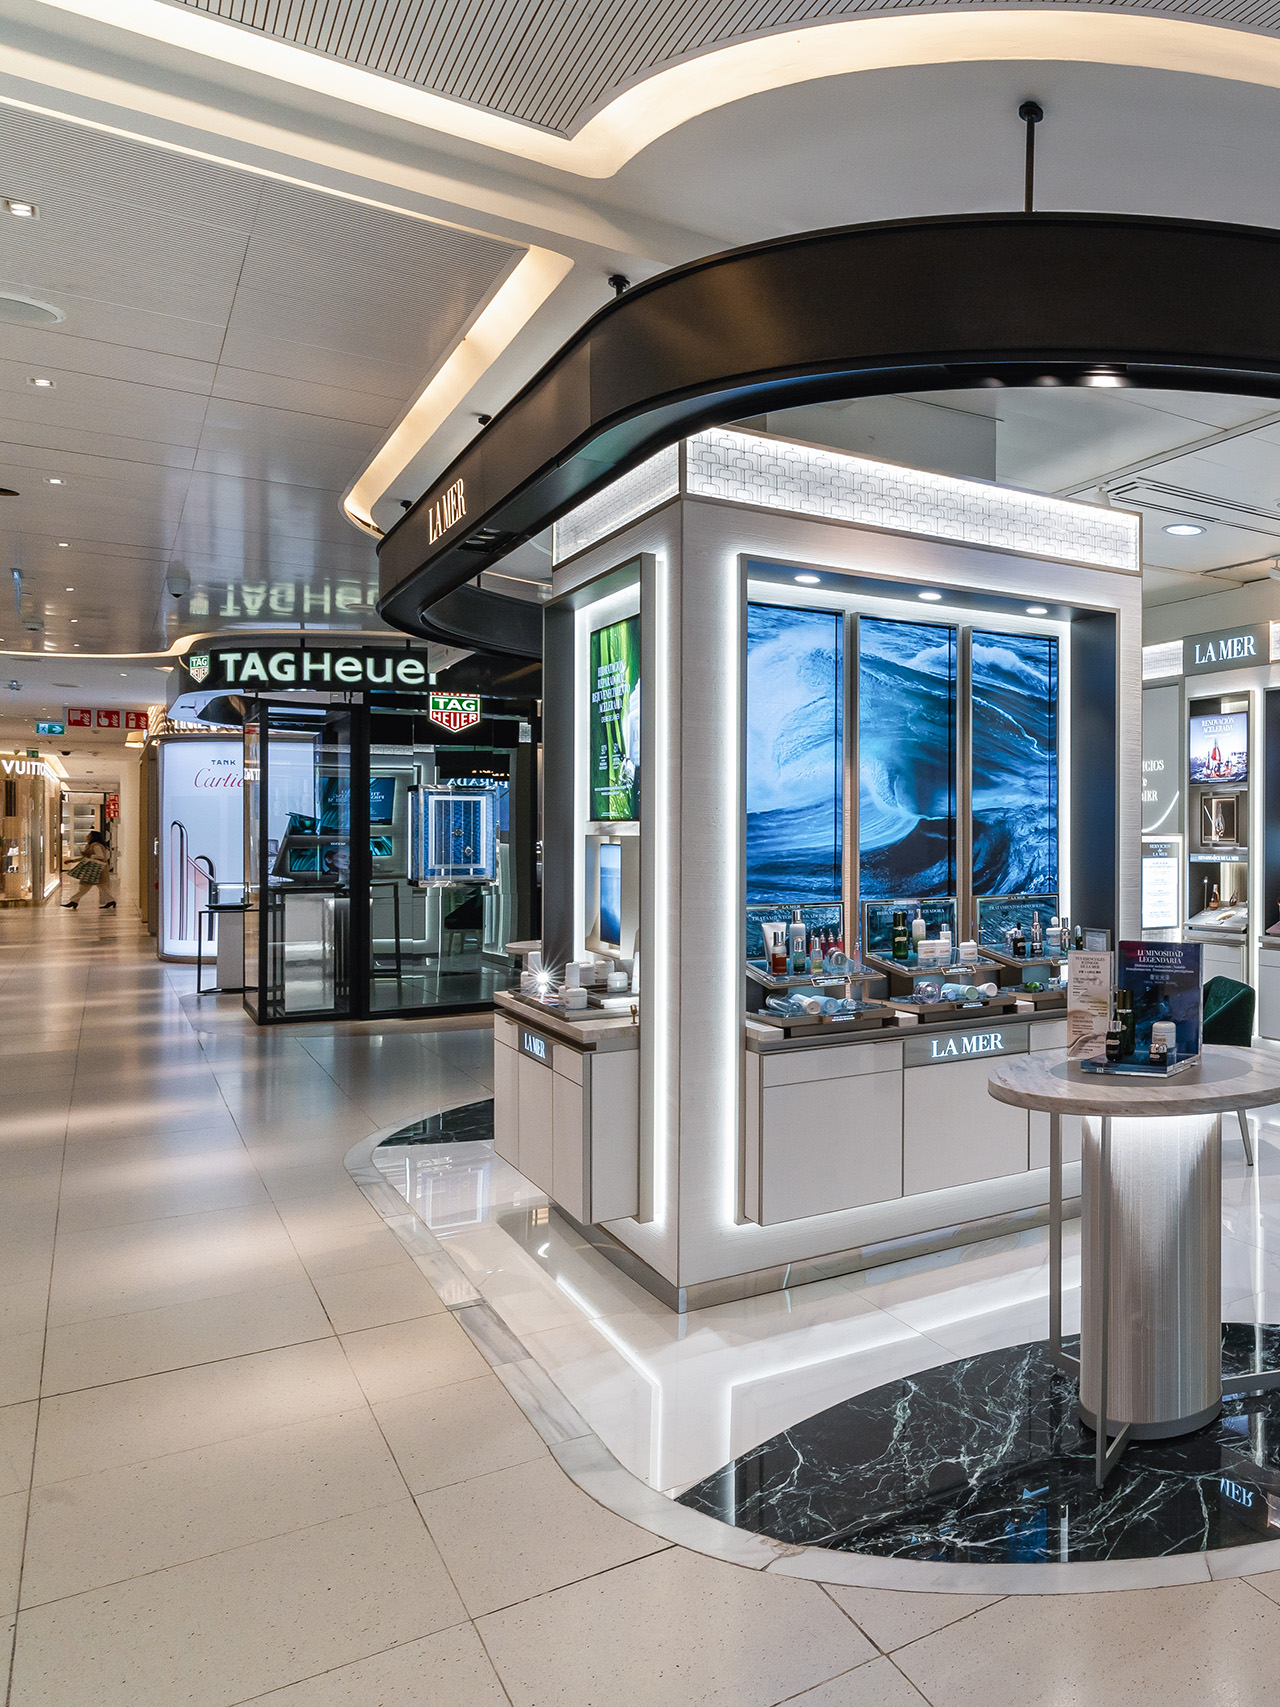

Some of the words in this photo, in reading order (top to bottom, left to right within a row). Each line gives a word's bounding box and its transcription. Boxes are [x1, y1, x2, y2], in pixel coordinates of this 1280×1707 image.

[428, 501, 443, 545] LA
[442, 478, 467, 533] MER
[1195, 641, 1217, 664] LA
[1218, 635, 1256, 661] MER
[191, 657, 208, 667] TAG
[434, 697, 476, 711] TAG
[432, 711, 477, 730] HEUER
[1137, 949, 1184, 958] LUMINOSIDAD
[1138, 956, 1182, 964] LEGENDARIA
[524, 1032, 533, 1053] LA
[532, 1036, 546, 1060] MER
[931, 1038, 959, 1058] LA
[961, 1033, 1004, 1054] MER
